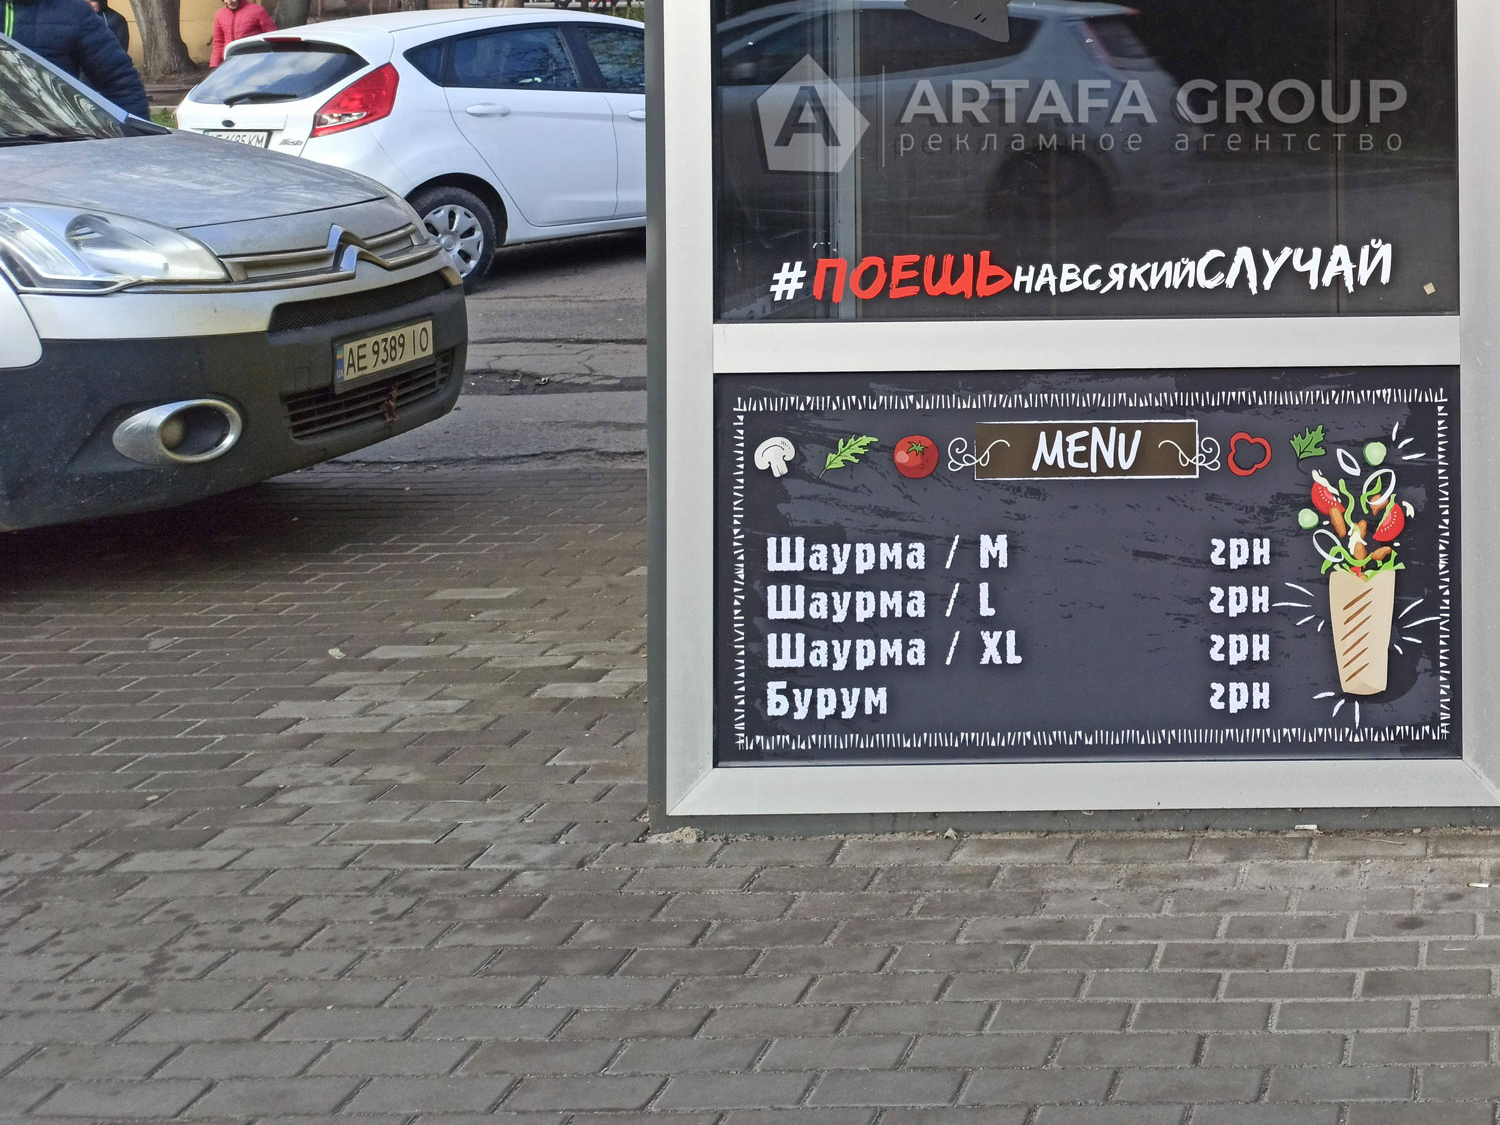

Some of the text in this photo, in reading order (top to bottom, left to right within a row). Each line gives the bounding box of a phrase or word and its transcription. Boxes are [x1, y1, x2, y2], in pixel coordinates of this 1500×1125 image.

[346, 343, 368, 376] AE
[372, 333, 405, 368] 9389
[1031, 426, 1142, 473] MENU
[767, 537, 925, 574] Шаурма
[980, 535, 1007, 568] M
[1211, 538, 1270, 569] грн
[767, 585, 925, 622] Шаурма
[980, 583, 995, 616] L
[1209, 586, 1269, 617] грн
[768, 633, 925, 670] Шаурма
[980, 630, 1022, 664] XL
[1210, 634, 1269, 665] грн
[767, 681, 887, 719] Бурум
[1210, 682, 1269, 713] грн
